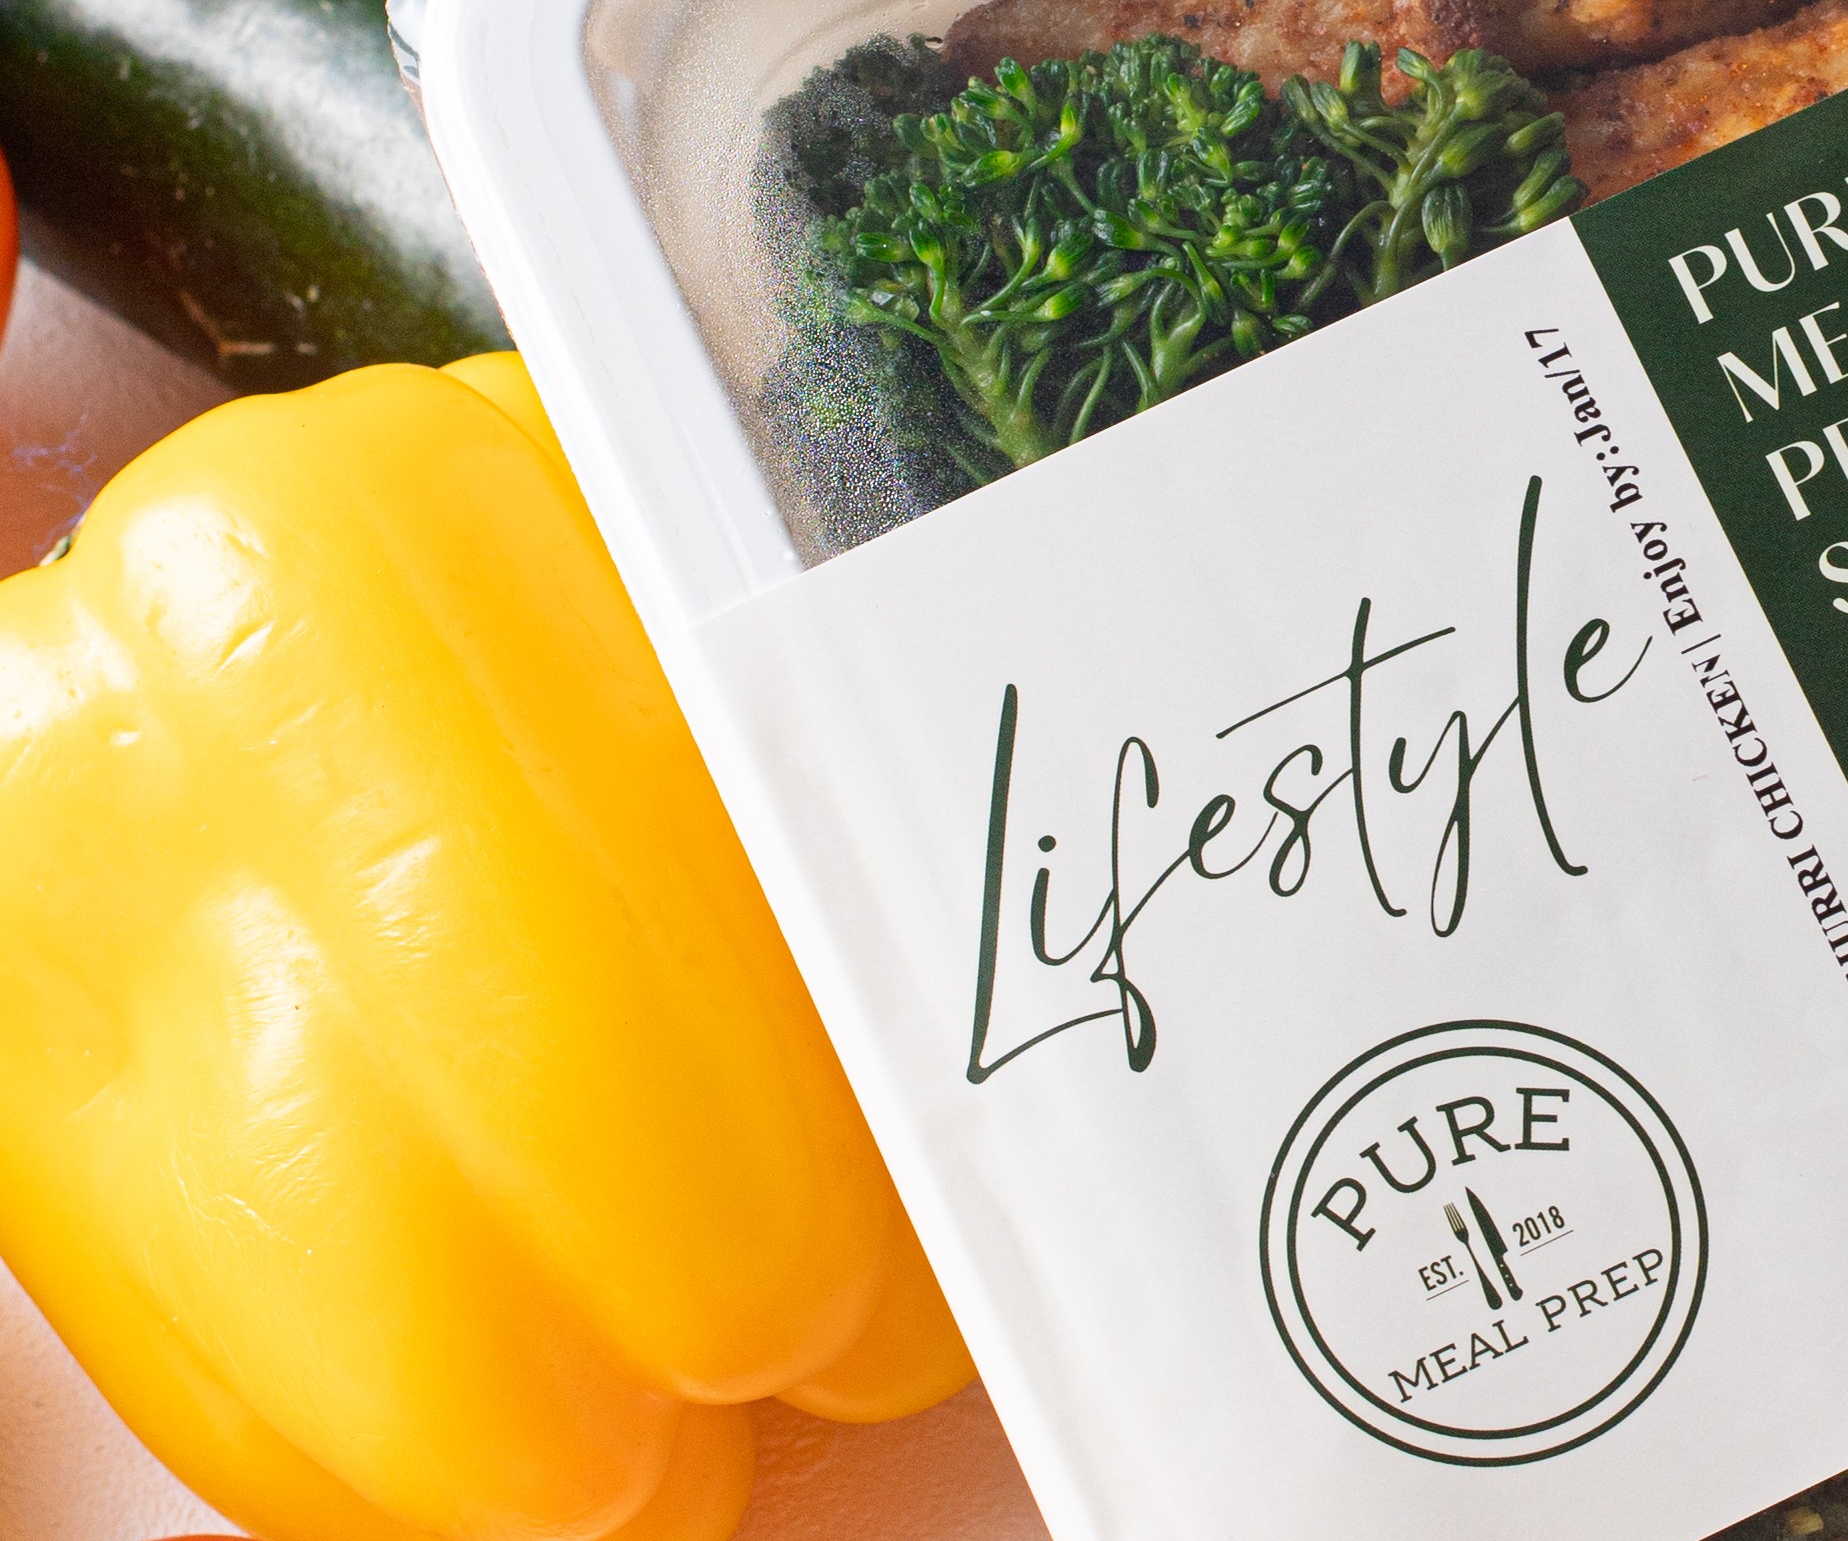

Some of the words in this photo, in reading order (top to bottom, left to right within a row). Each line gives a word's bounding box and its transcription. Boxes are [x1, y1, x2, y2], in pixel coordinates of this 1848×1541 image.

[1630, 521, 1704, 636] Enjoy
[966, 474, 1653, 1085] Lifestyle
[1691, 653, 1804, 840] CHICKEN
[1310, 1086, 1571, 1253] PURE
[1418, 1255, 1465, 1293] EST.
[1512, 1205, 1567, 1248] 2018
[1388, 1318, 1530, 1404] MEAL
[1534, 1247, 1665, 1333] PREP
